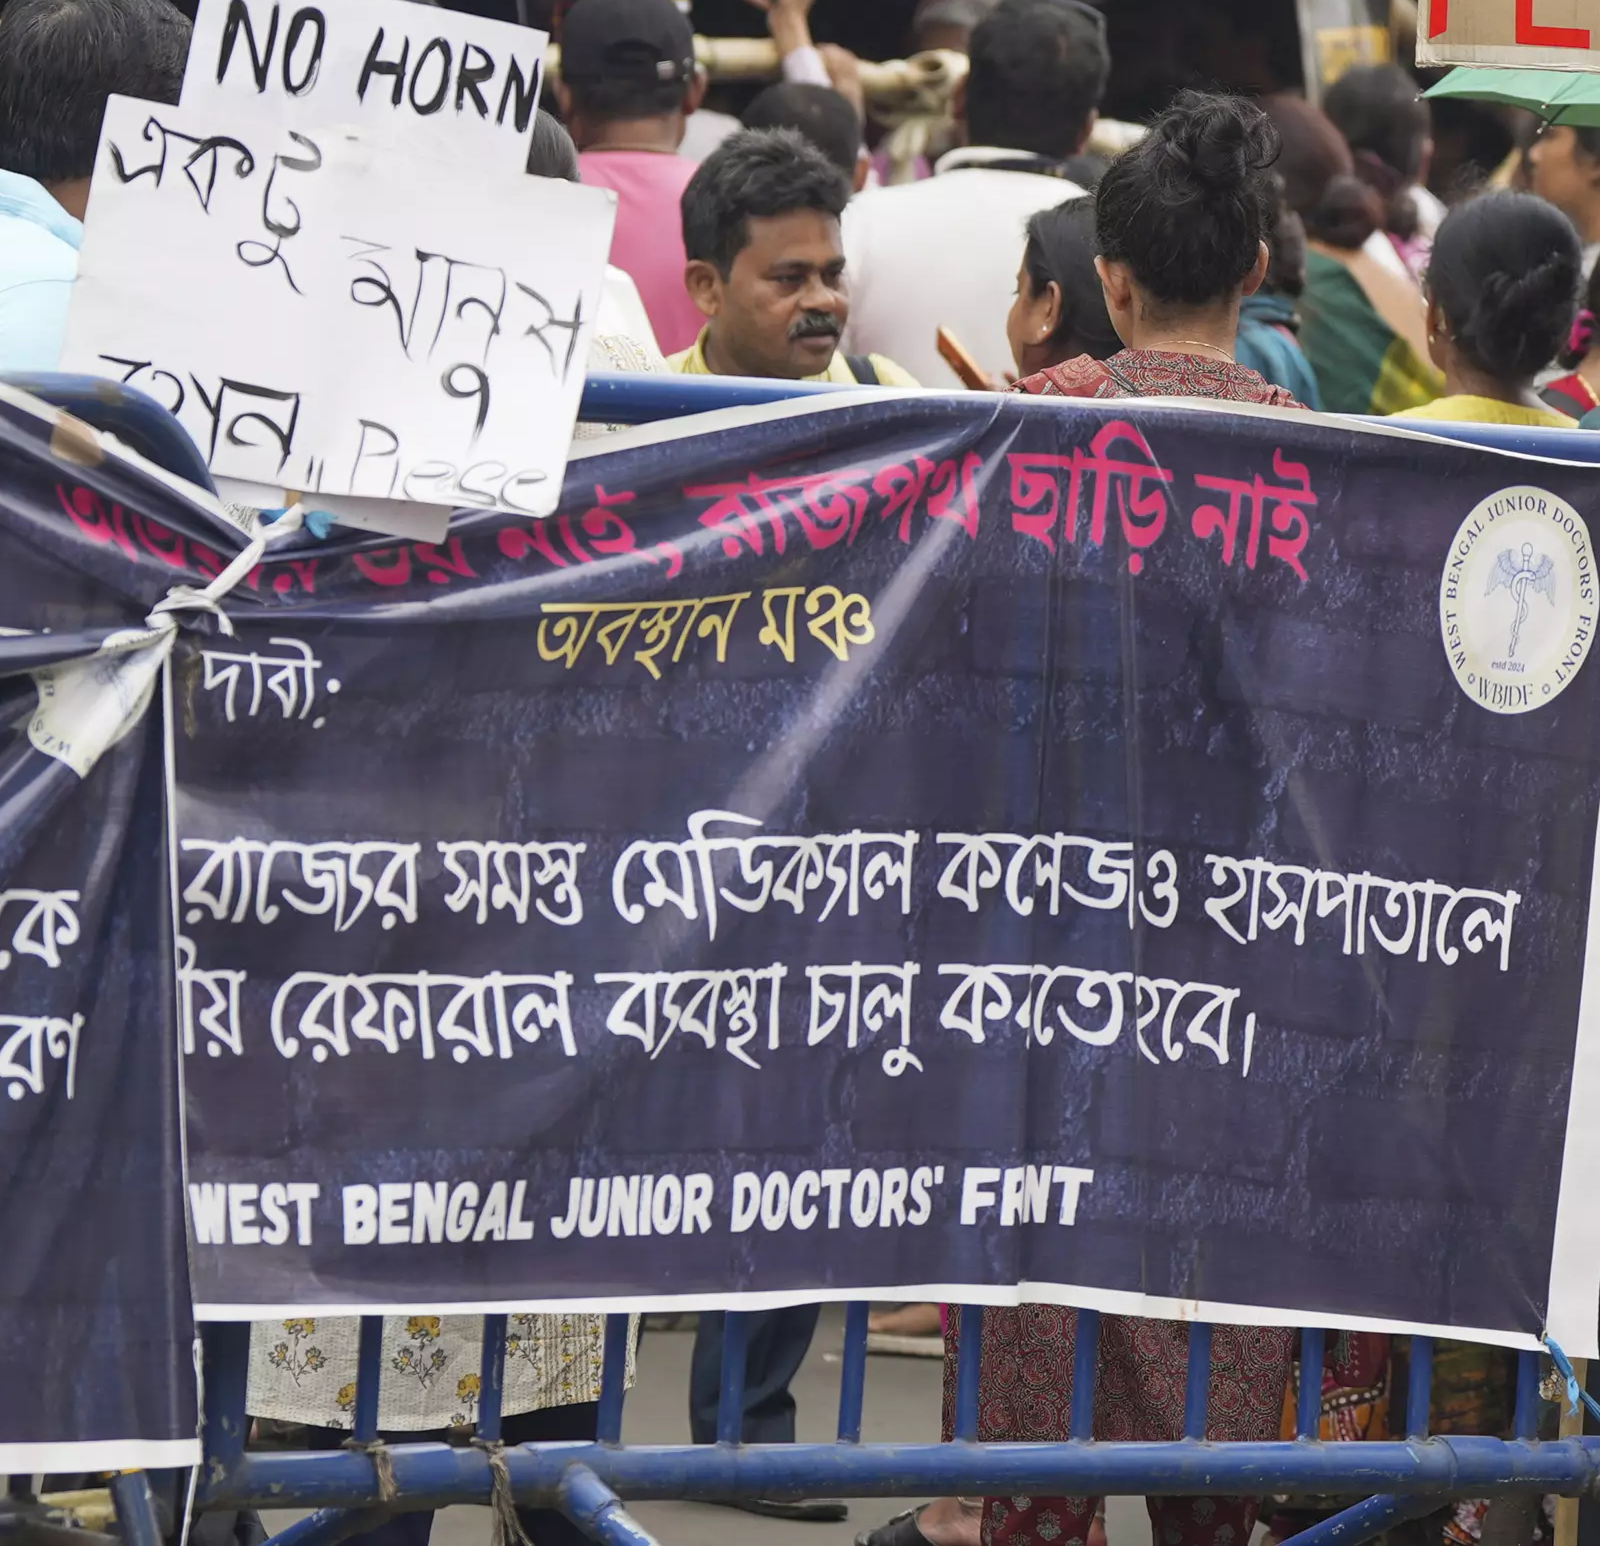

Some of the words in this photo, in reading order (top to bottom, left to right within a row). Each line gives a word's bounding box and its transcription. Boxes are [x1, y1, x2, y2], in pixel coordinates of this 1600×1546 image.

[357, 25, 543, 135] HORN
[107, 115, 324, 296] একটু
[684, 447, 984, 561] রাজপথ
[1005, 419, 1176, 576] ছাড়ি
[1192, 446, 1320, 582] নাই
[1486, 494, 1549, 523] JUNIOR
[1445, 518, 1486, 601] BENGAL
[1551, 506, 1595, 607] DOCTORS'
[536, 590, 753, 681] অবস্থান
[758, 583, 877, 664] মঞ্চ
[1445, 609, 1468, 672] WEST
[1507, 660, 1526, 674] 2024
[1555, 613, 1594, 686] FRONT
[1475, 675, 1536, 711] WBJDF
[179, 835, 422, 933] রাজ্যের
[436, 839, 588, 927] সমস্ত
[611, 809, 921, 943] মেডিক্যাল
[1202, 852, 1522, 973] হাসপাতালে
[270, 968, 576, 1063] রেফারাল
[593, 961, 789, 1071] ব্যবস্থা
[805, 960, 927, 1078] চালু
[188, 1181, 321, 1248] WEST
[341, 1177, 537, 1247] BENGAL
[548, 1171, 715, 1241] JUNIOR
[730, 1164, 946, 1234] DOCTORS'
[959, 1162, 1095, 1229] FRNT
